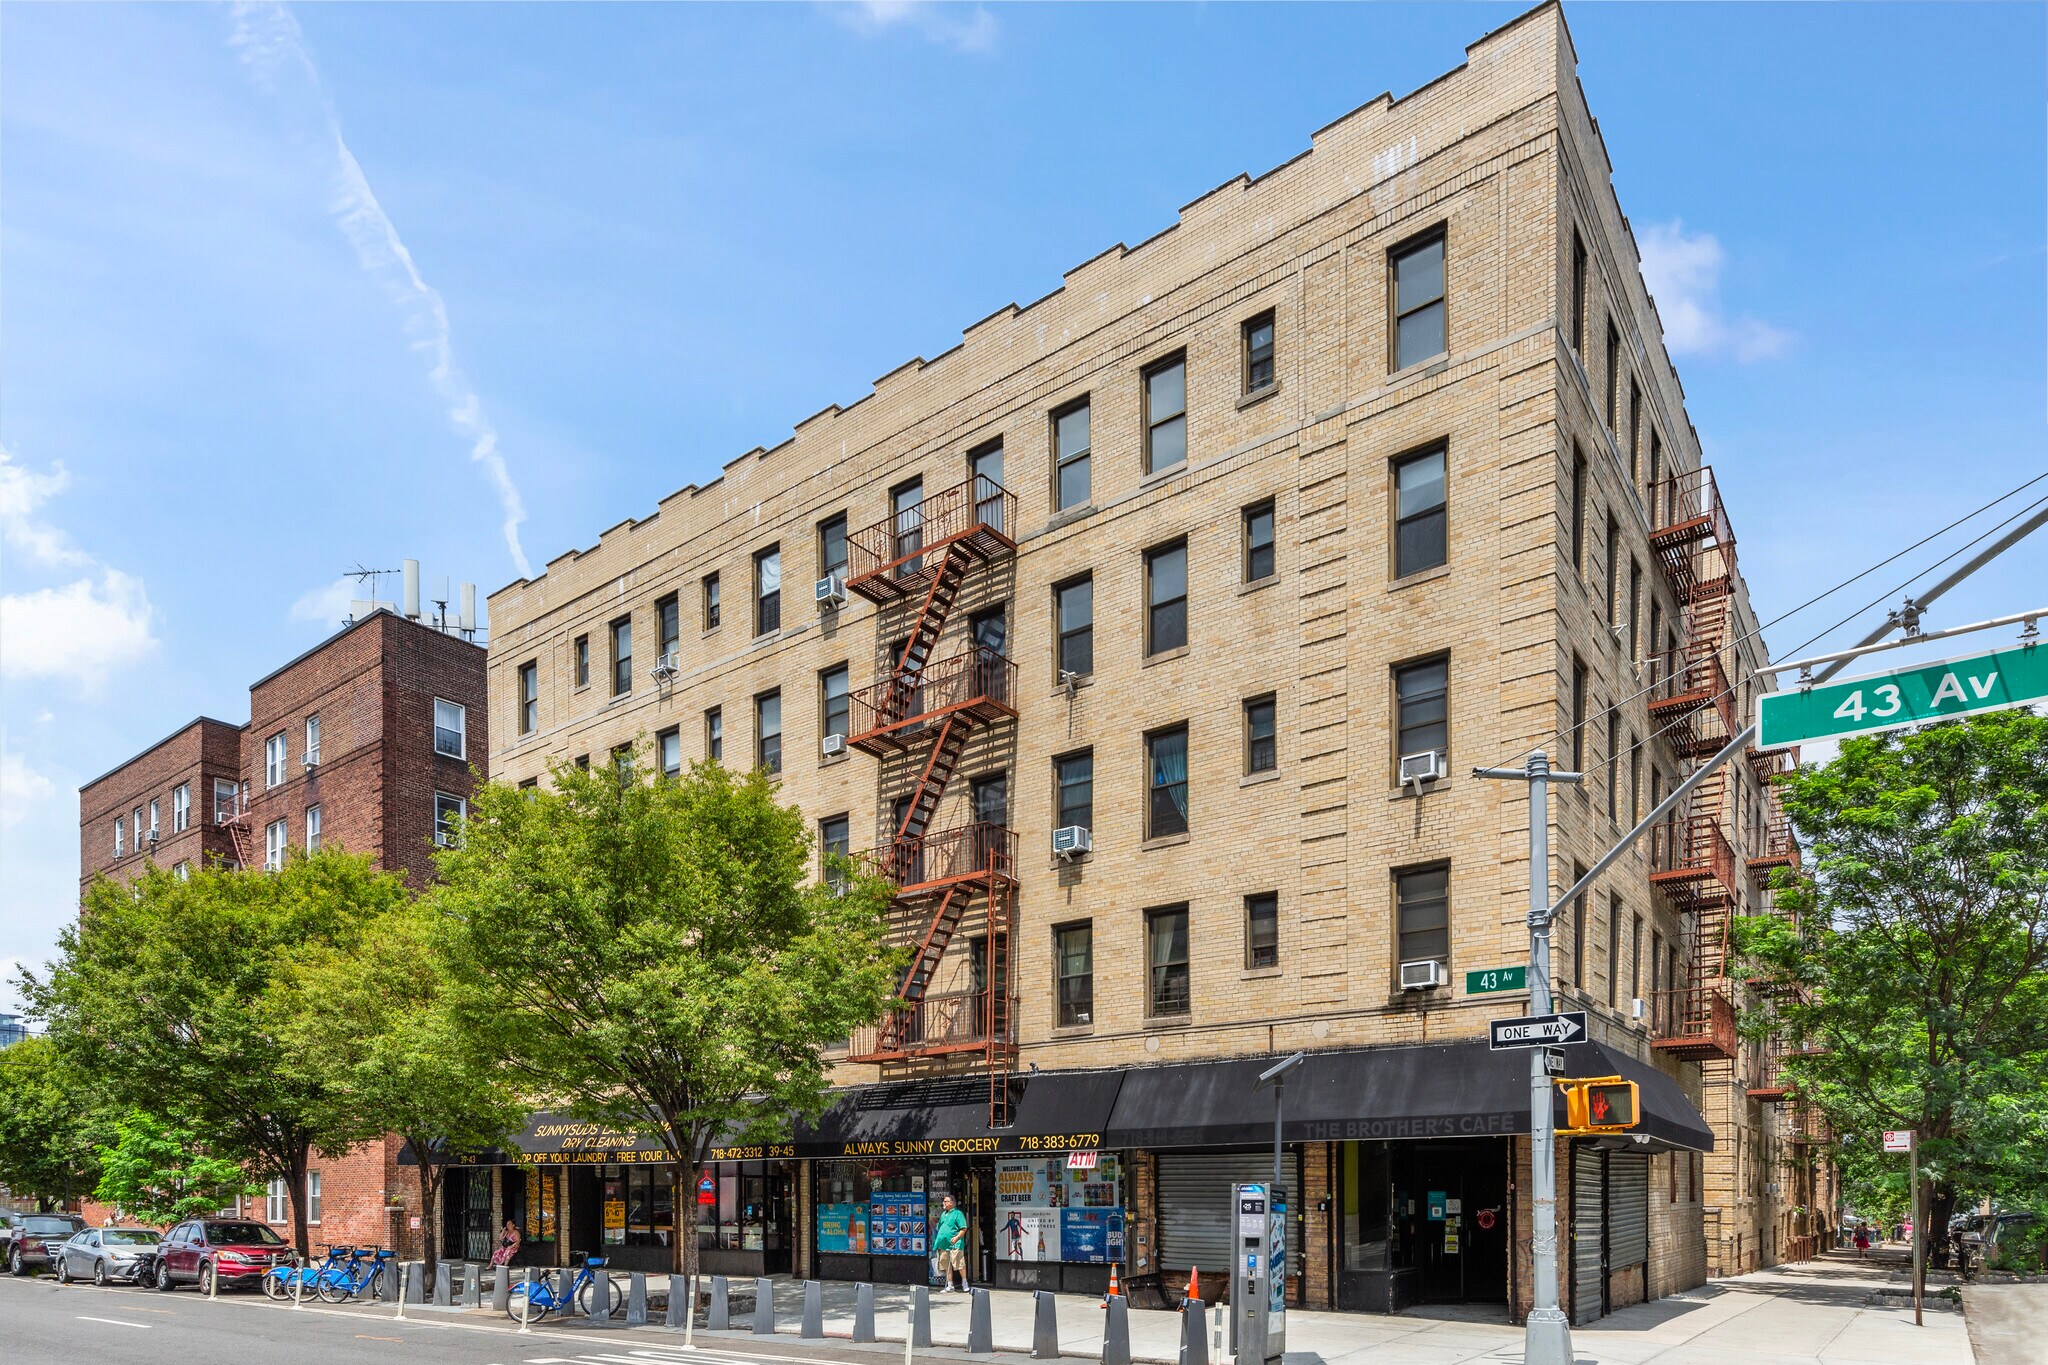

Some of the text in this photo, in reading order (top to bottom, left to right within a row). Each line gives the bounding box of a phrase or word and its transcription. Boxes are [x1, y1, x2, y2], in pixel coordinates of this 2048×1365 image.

[1833, 671, 1999, 722] 43 Av
[1480, 971, 1513, 990] 43 Av
[1504, 1022, 1571, 1040] ONE WAY
[1555, 1056, 1563, 1069] WAY
[534, 1123, 600, 1137] SUNNYSUDS
[1304, 1112, 1514, 1140] THE BROTHER'S CAFÉ
[561, 1136, 637, 1149] DRY CLEANING
[844, 1134, 1099, 1155] ALWAYS SUNNY GROCERY 718-383-6779
[533, 1153, 547, 1163] OFF
[549, 1153, 570, 1163] YOUR
[572, 1152, 608, 1163] LAUNDRY
[616, 1152, 636, 1162] FREE
[639, 1151, 663, 1162] YOUR
[711, 1145, 795, 1159] 718-472-3312 39-45
[1069, 1151, 1096, 1166] ATM
[998, 1171, 1034, 1182] ALWAYS
[931, 1180, 947, 1188] SUNNY
[998, 1182, 1034, 1194] SUNNY
[1001, 1194, 1032, 1202] CRAFT BEER
[822, 1221, 841, 1229] BRING
[826, 1228, 846, 1236] ALOHA
[1107, 1231, 1123, 1239] BUD
